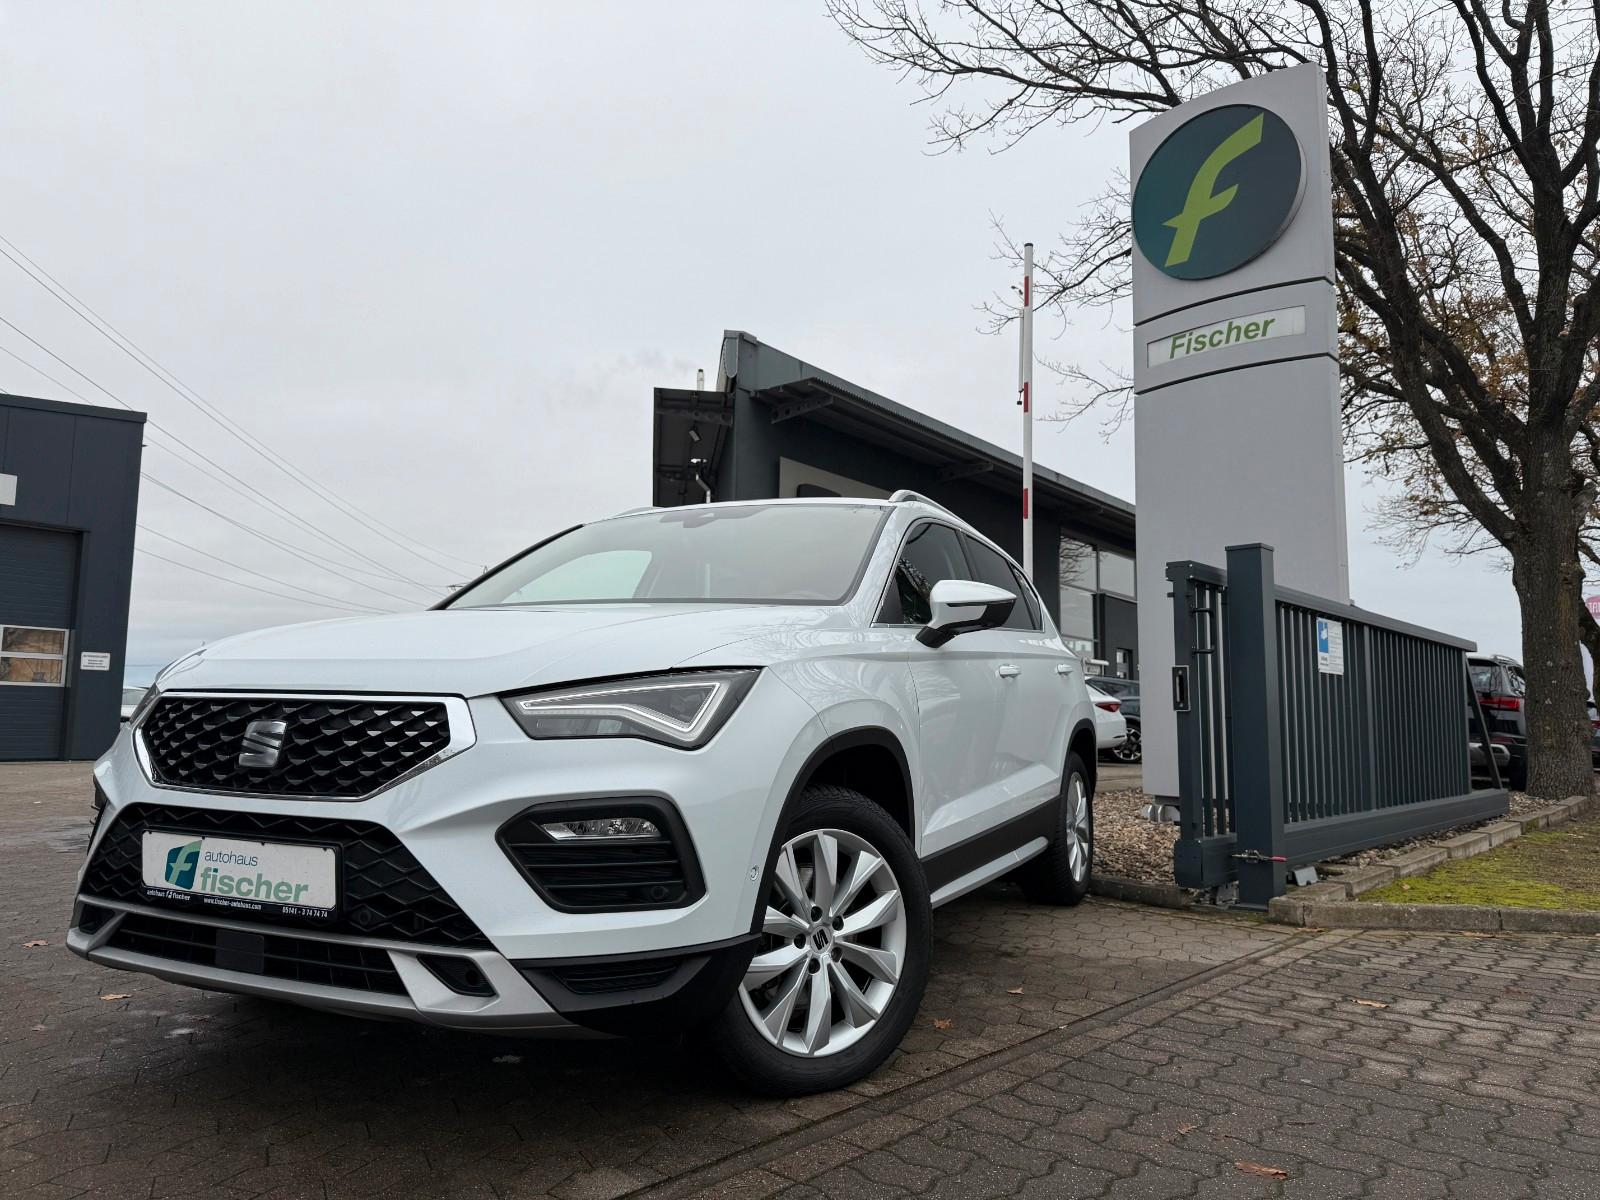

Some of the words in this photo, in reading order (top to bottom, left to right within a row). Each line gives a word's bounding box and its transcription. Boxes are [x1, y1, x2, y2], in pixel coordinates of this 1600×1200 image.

[1169, 318, 1276, 360] Fischer
[204, 849, 259, 867] autohaus
[200, 866, 309, 903] fischer
[321, 910, 328, 918] 74
